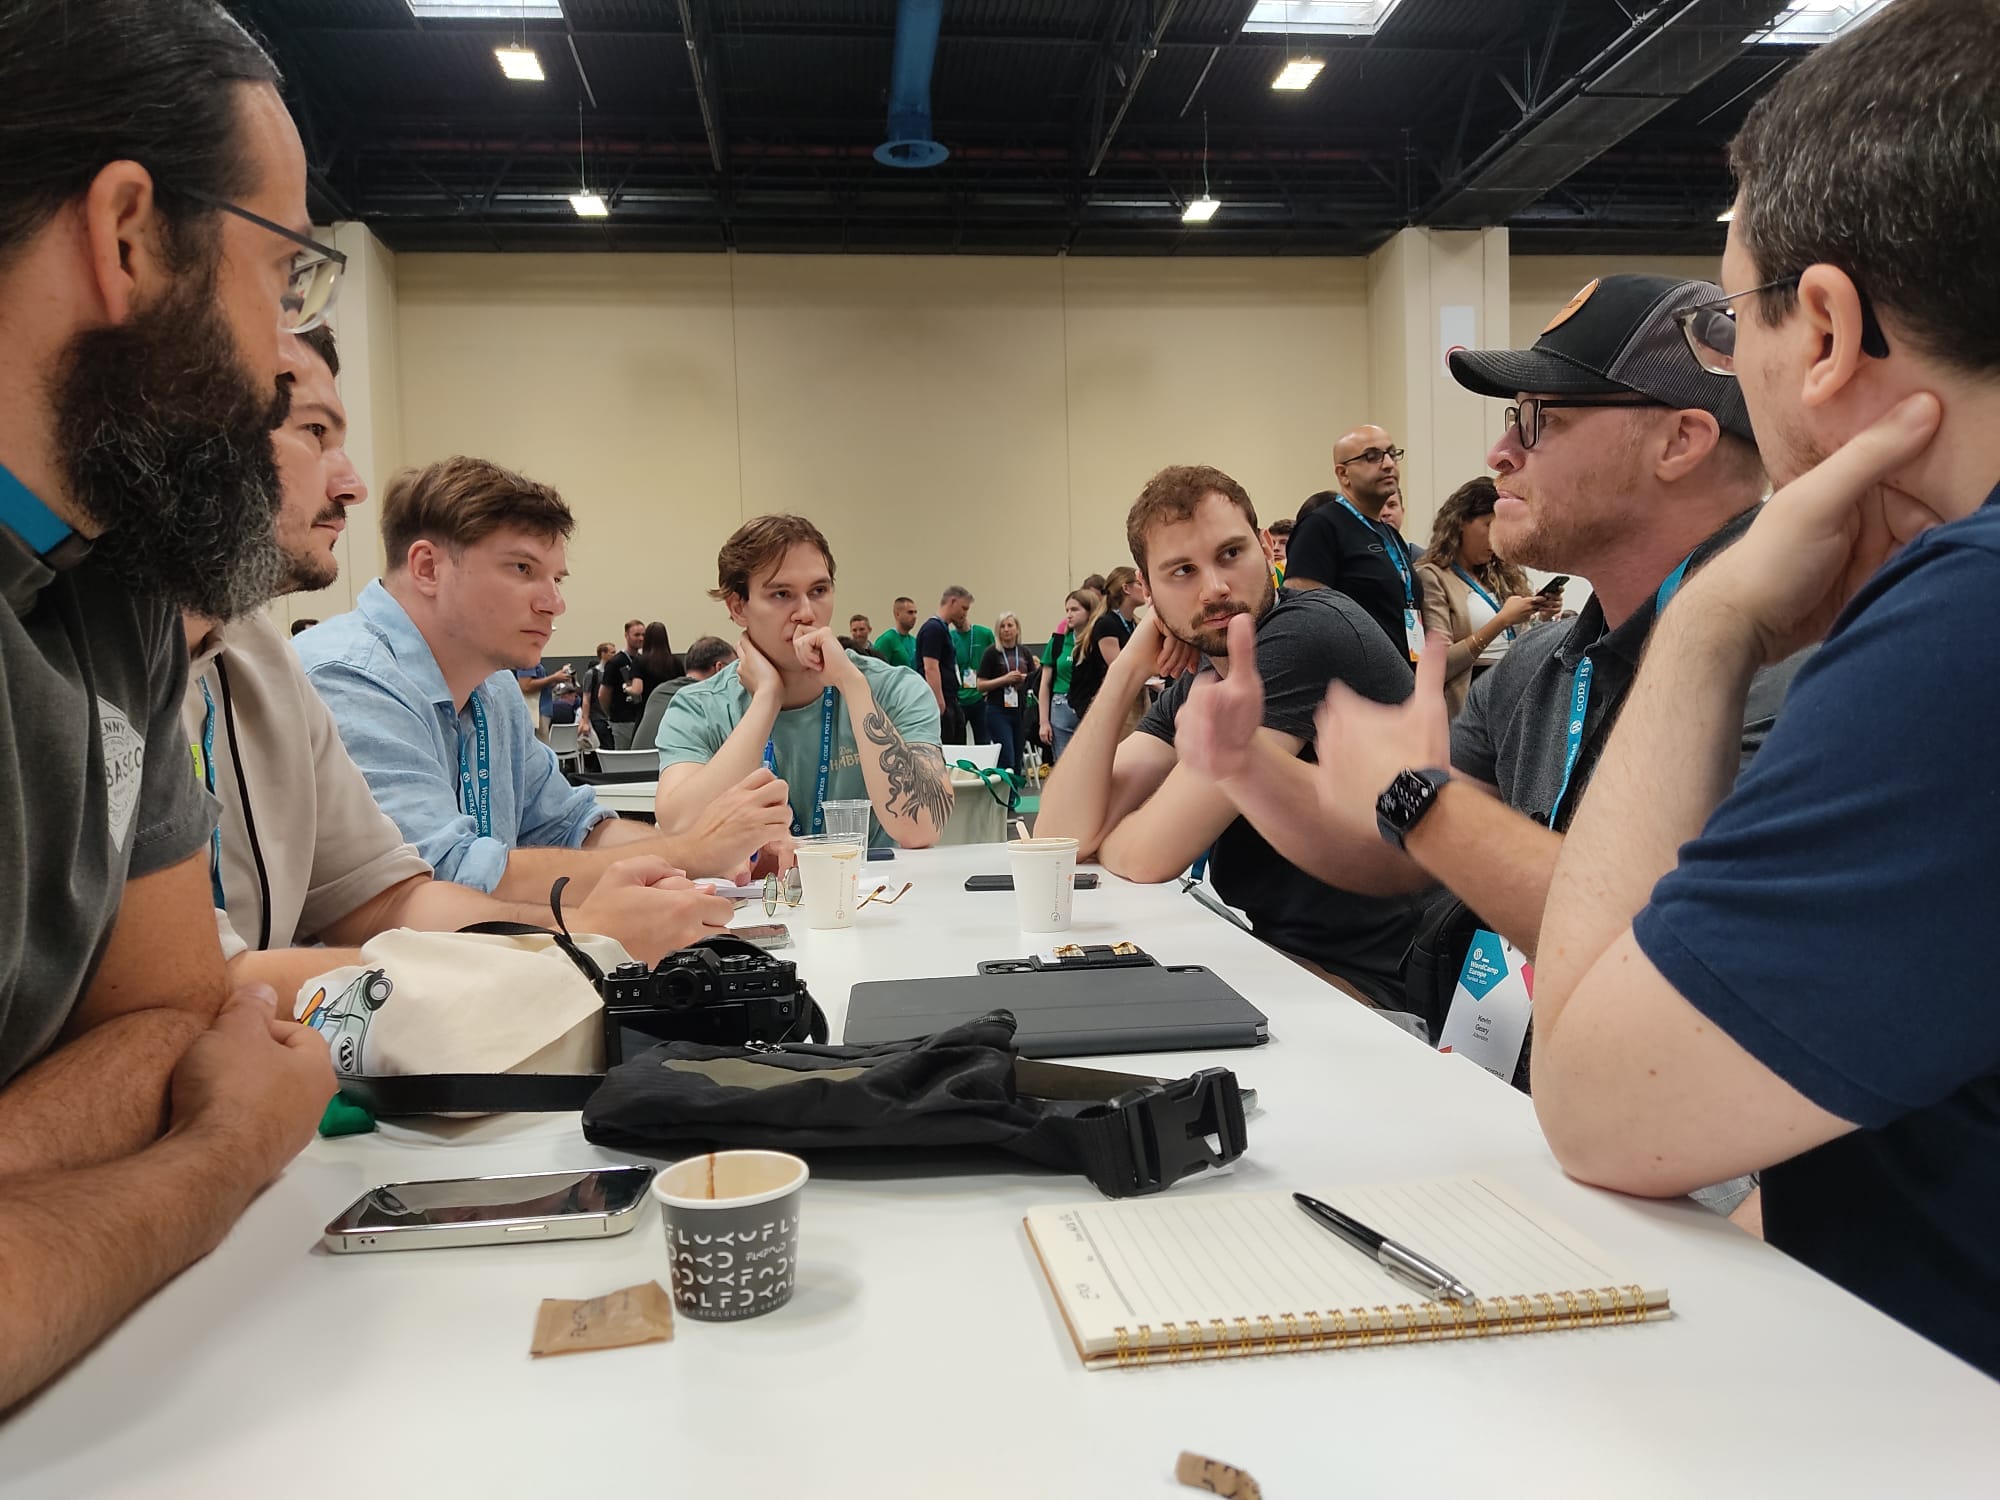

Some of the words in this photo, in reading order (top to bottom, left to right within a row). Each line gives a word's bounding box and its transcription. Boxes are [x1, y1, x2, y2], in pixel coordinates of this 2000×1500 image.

[1580, 667, 1590, 677] IS
[1577, 681, 1586, 711] CODE
[102, 720, 126, 736] NNY
[478, 719, 484, 728] IS
